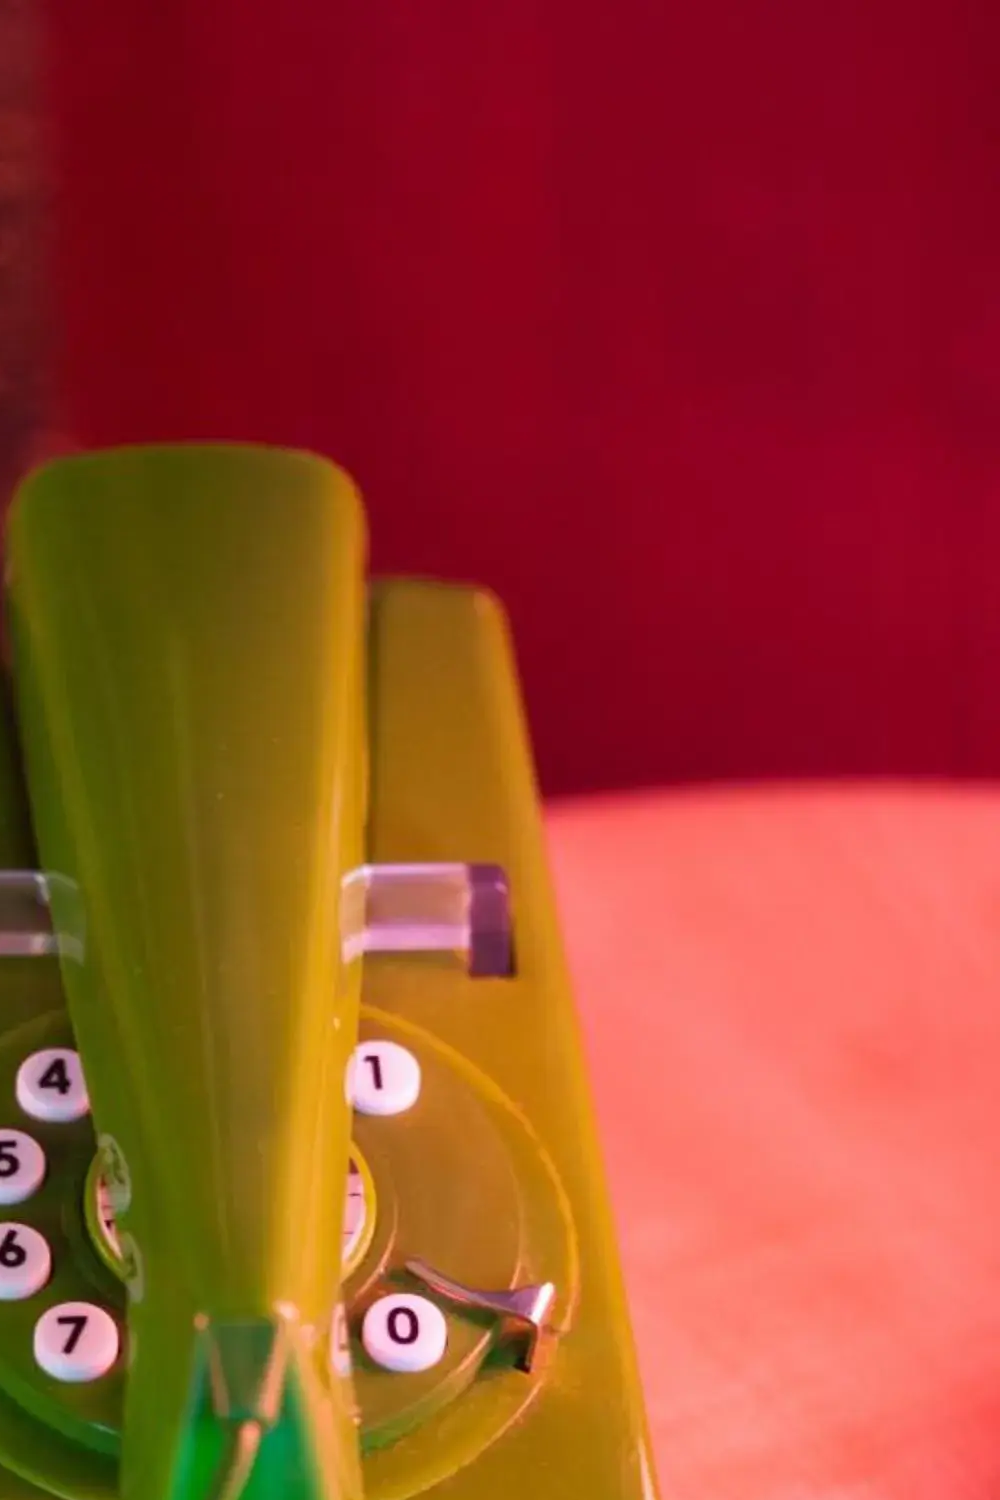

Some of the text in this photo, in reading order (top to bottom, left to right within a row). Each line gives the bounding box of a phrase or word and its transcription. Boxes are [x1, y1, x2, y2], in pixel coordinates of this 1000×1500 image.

[38, 1058, 71, 1095] 4
[363, 1055, 383, 1090] 1
[57, 1315, 88, 1354] 7
[386, 1306, 420, 1344] 0
